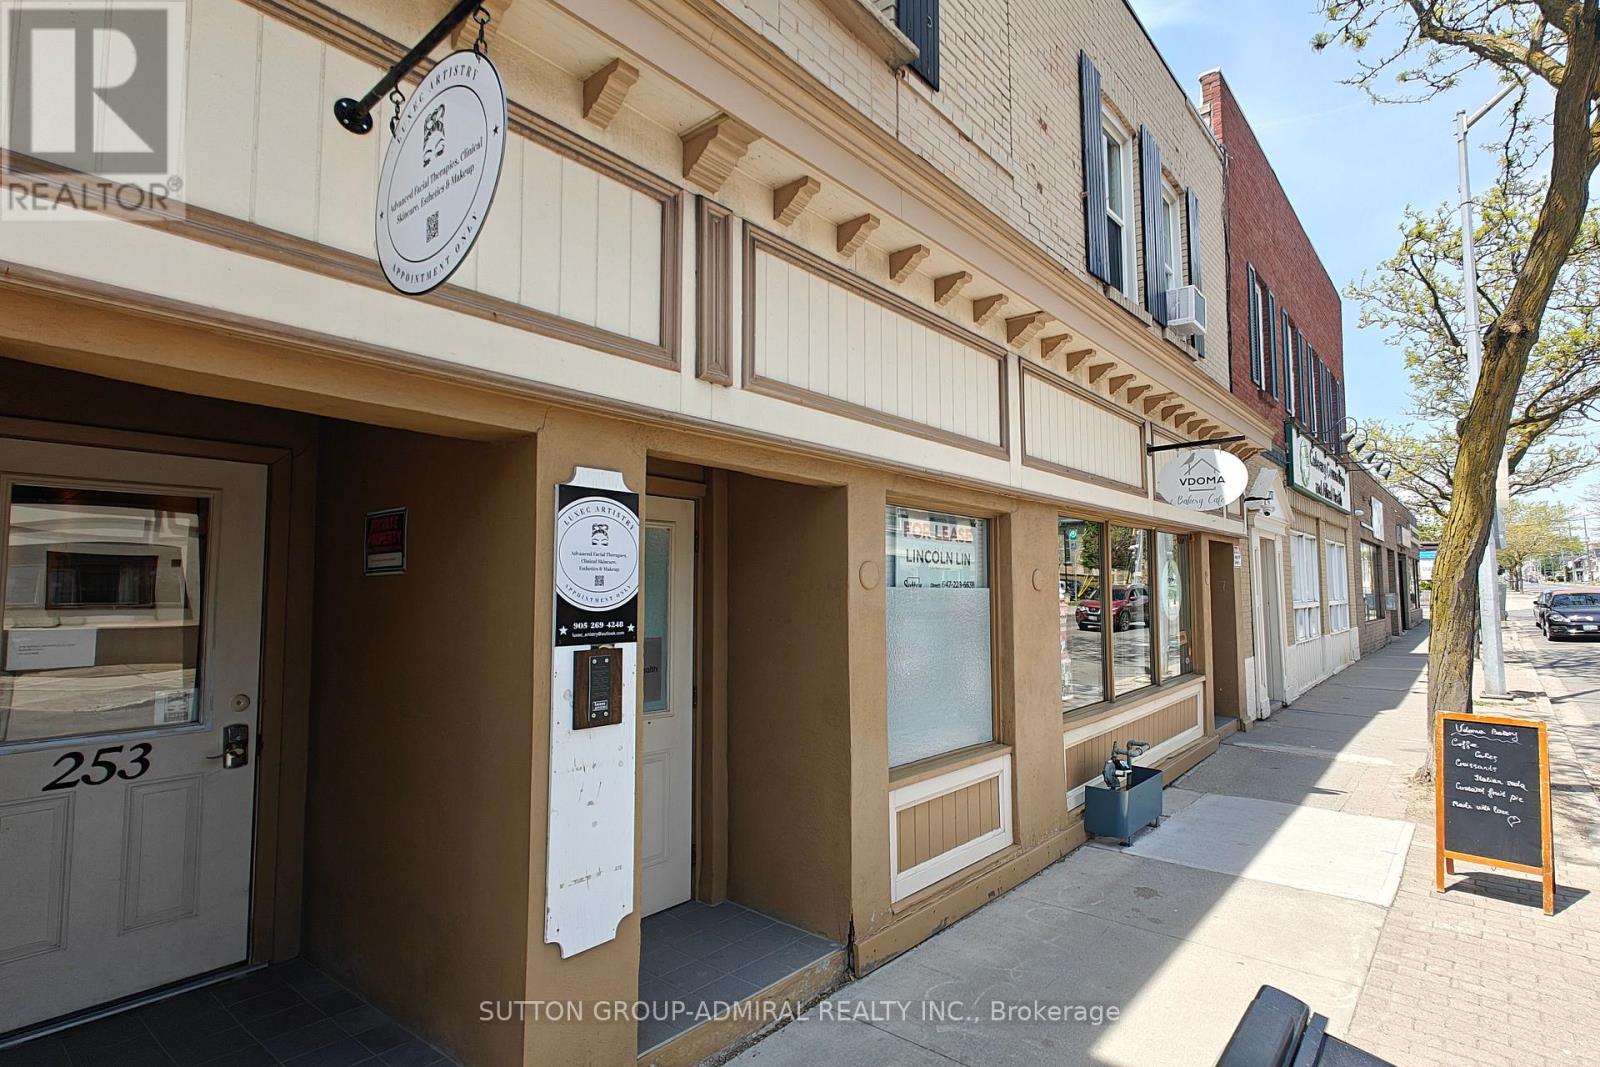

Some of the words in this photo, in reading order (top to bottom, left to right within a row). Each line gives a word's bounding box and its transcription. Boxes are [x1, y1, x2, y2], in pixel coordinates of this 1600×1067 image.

[428, 64, 478, 93] ARTISTRY
[391, 187, 414, 212] Advanced
[414, 177, 430, 196] Facial
[460, 136, 483, 161] Clinical
[420, 185, 445, 208] Esthetics
[451, 164, 475, 185] Makeup
[392, 255, 449, 284] APPOINTMENT
[455, 211, 477, 253] ONLY
[1179, 475, 1226, 486] VDOMA
[1176, 494, 1204, 509] Bakery
[595, 505, 634, 530] ARTISTRY
[903, 520, 931, 540] FOR
[935, 524, 973, 543] LEASE
[906, 548, 953, 566] LINCOLN
[955, 553, 971, 566] LIN
[564, 584, 613, 603] APPOINTMENT
[573, 622, 588, 630] 905
[590, 621, 604, 629] 269
[605, 620, 624, 628] 4248
[41, 742, 153, 792] 253
[1487, 787, 1507, 799] fruit
